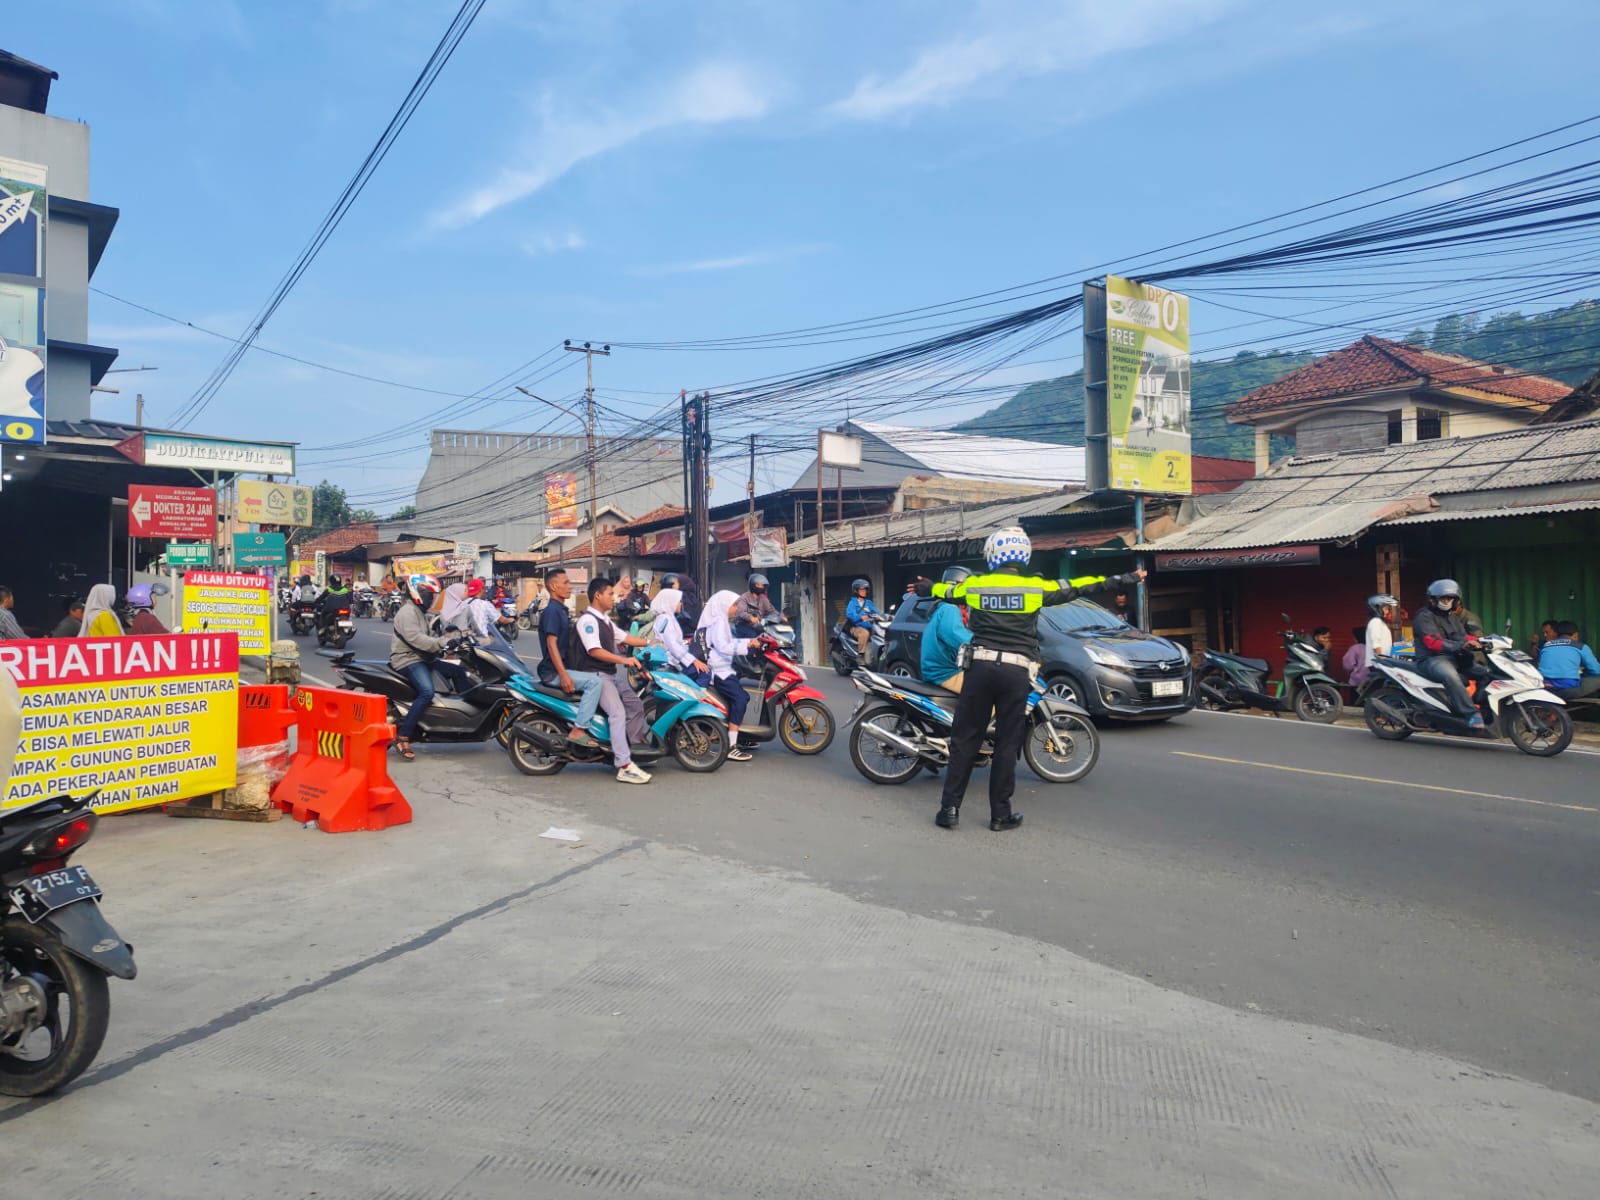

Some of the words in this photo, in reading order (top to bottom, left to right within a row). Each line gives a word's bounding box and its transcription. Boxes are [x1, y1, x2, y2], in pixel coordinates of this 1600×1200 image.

[1162, 293, 1179, 332] 0
[1110, 328, 1135, 346] FREE
[1168, 461, 1174, 478] 2
[153, 502, 185, 514] DOKTER
[186, 503, 195, 515] 24
[197, 504, 213, 517] JAM
[191, 574, 223, 585] JALAN
[200, 589, 224, 598] JALAN
[240, 591, 260, 600] ARAH
[981, 594, 1024, 610] POLISI
[0, 639, 176, 680] RHATIAN
[21, 691, 106, 709] ASAMANYA
[110, 684, 156, 701] UNTUK
[160, 679, 235, 697] SEMENTARA
[22, 714, 69, 731] EMUA
[73, 704, 161, 725] KENDARAAN
[165, 700, 208, 715] BESAR
[32, 735, 68, 751] BISA
[72, 725, 144, 747] MELEWATI
[148, 721, 190, 737] JALUR
[71, 748, 133, 768] GUNUNG
[137, 740, 191, 758] BUNDER
[8, 784, 43, 800] ADA
[47, 768, 136, 793] PEKERJAAN
[140, 755, 217, 778] PEMBUATAN
[135, 781, 179, 799] TANAH
[31, 871, 75, 893] 2752
[76, 867, 88, 880] F
